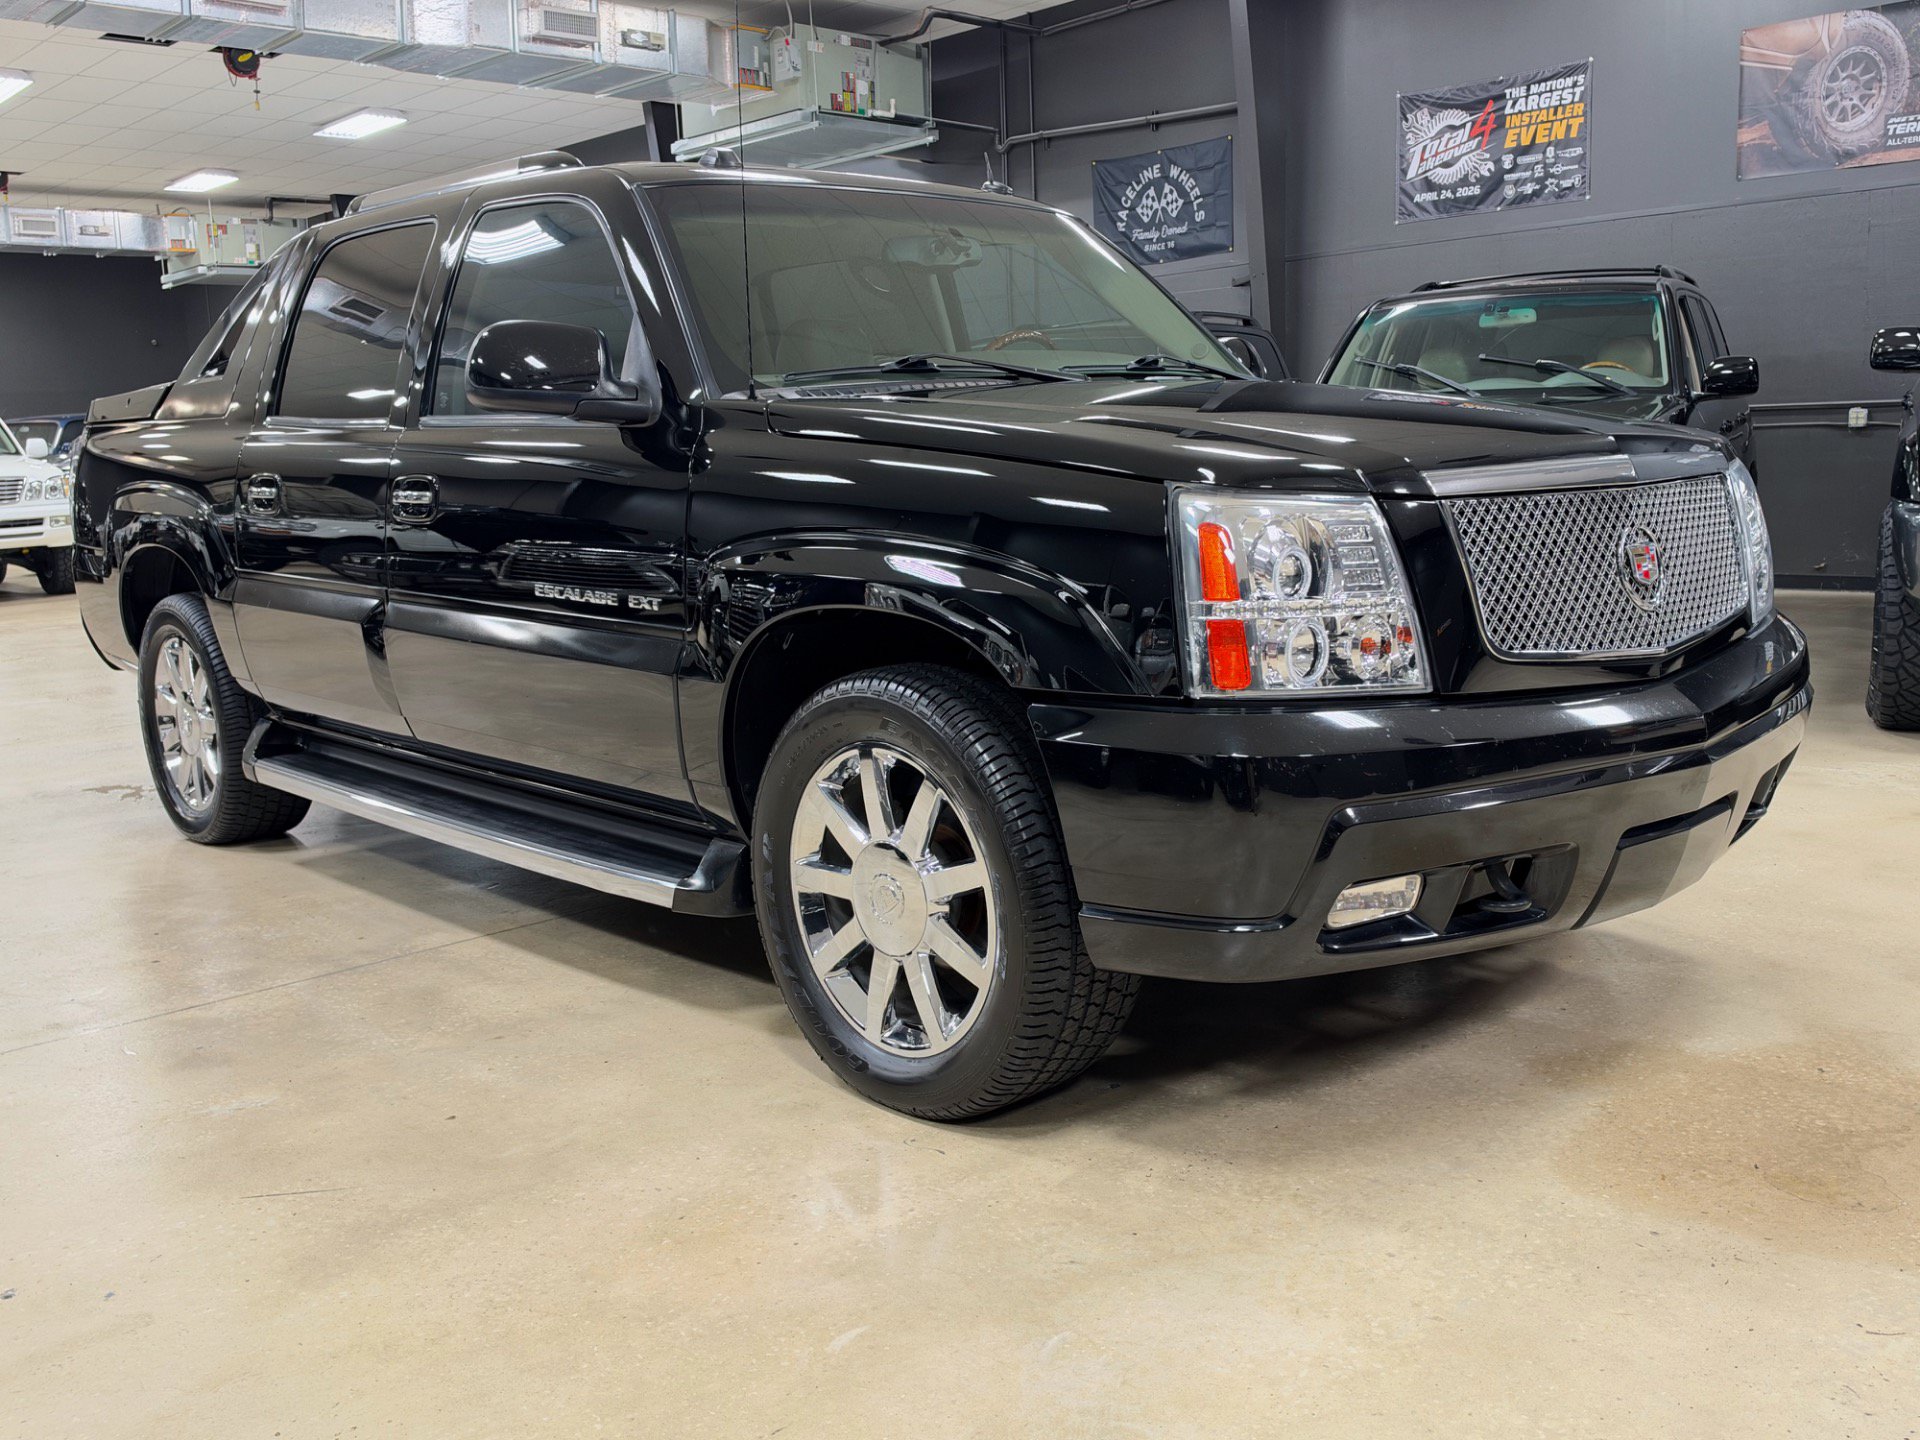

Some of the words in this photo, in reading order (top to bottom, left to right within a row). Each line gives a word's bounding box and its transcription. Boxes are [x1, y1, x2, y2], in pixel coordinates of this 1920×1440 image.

[1504, 85, 1528, 100] THE
[1529, 74, 1586, 95] NATION'S
[1504, 86, 1585, 115] LARGEST
[1504, 102, 1586, 129] INSTALLER
[1406, 121, 1473, 181] Total
[1470, 99, 1498, 150] 4
[1504, 117, 1585, 149] EVENT
[1116, 163, 1162, 232] RACELINE
[1169, 163, 1206, 223] WHEELS
[1413, 191, 1439, 203] APRIL
[1131, 226, 1160, 243] Family
[1161, 221, 1188, 239] Owned
[1144, 242, 1166, 252] SINCE
[534, 583, 619, 606] ESCALADE
[628, 594, 662, 612] EXT
